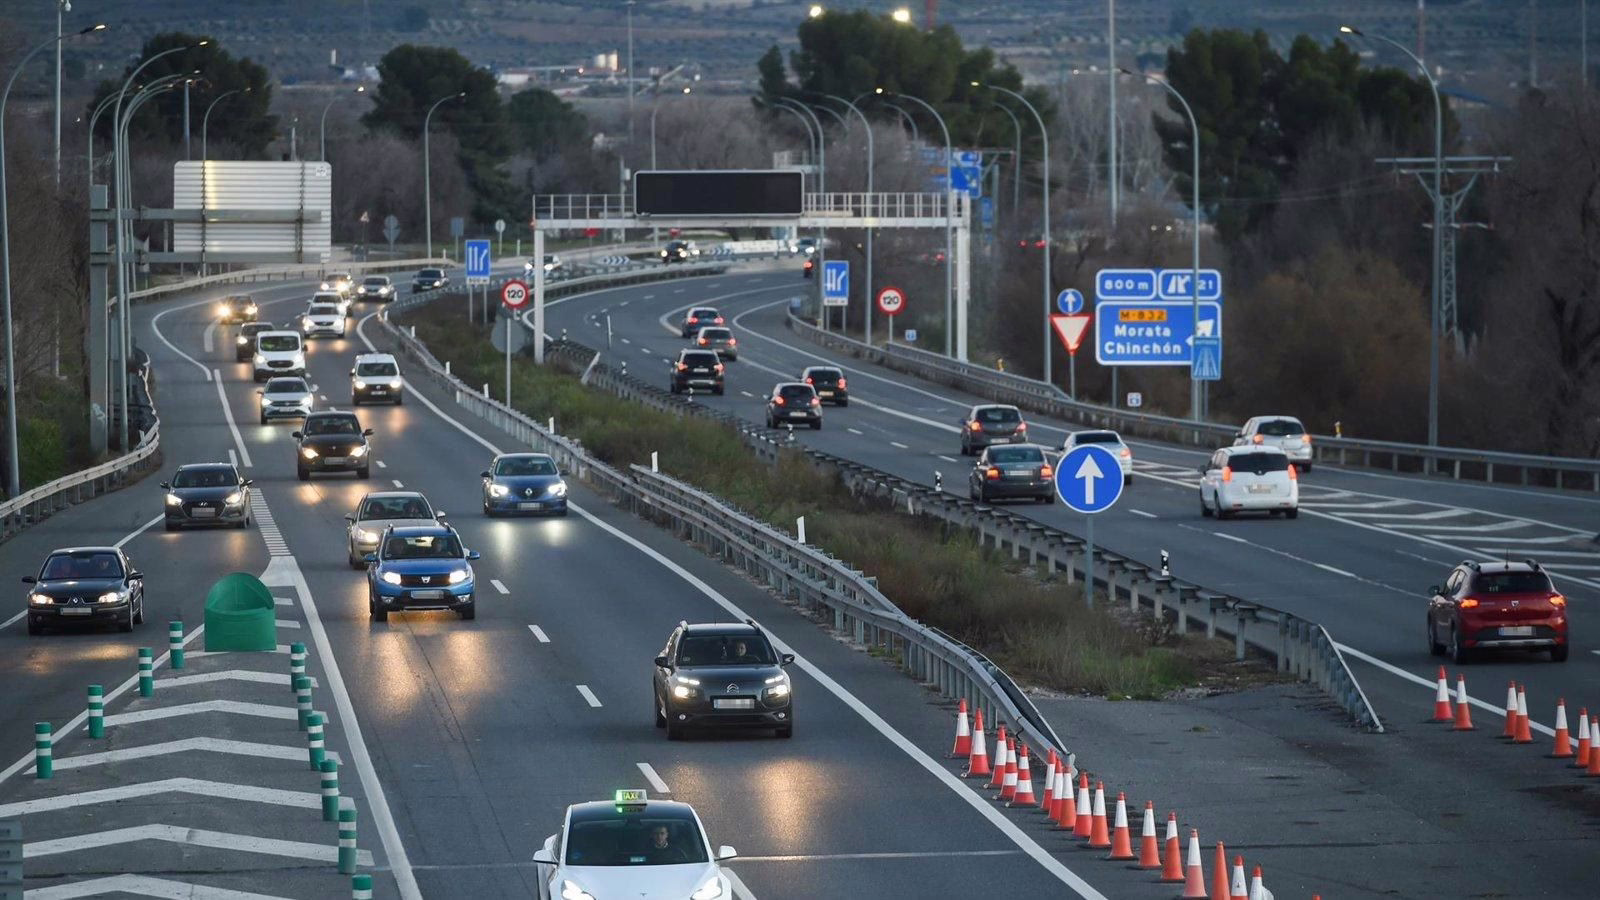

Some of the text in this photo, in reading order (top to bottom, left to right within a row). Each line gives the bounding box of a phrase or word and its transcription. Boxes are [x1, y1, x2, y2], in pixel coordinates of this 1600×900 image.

[1104, 279, 1149, 290] 800 m
[1198, 279, 1213, 290] 21
[507, 289, 524, 299] 120
[883, 295, 899, 305] 120
[1120, 310, 1164, 321] M-832
[1114, 324, 1171, 337] Morata
[1104, 341, 1182, 355] Chinchón
